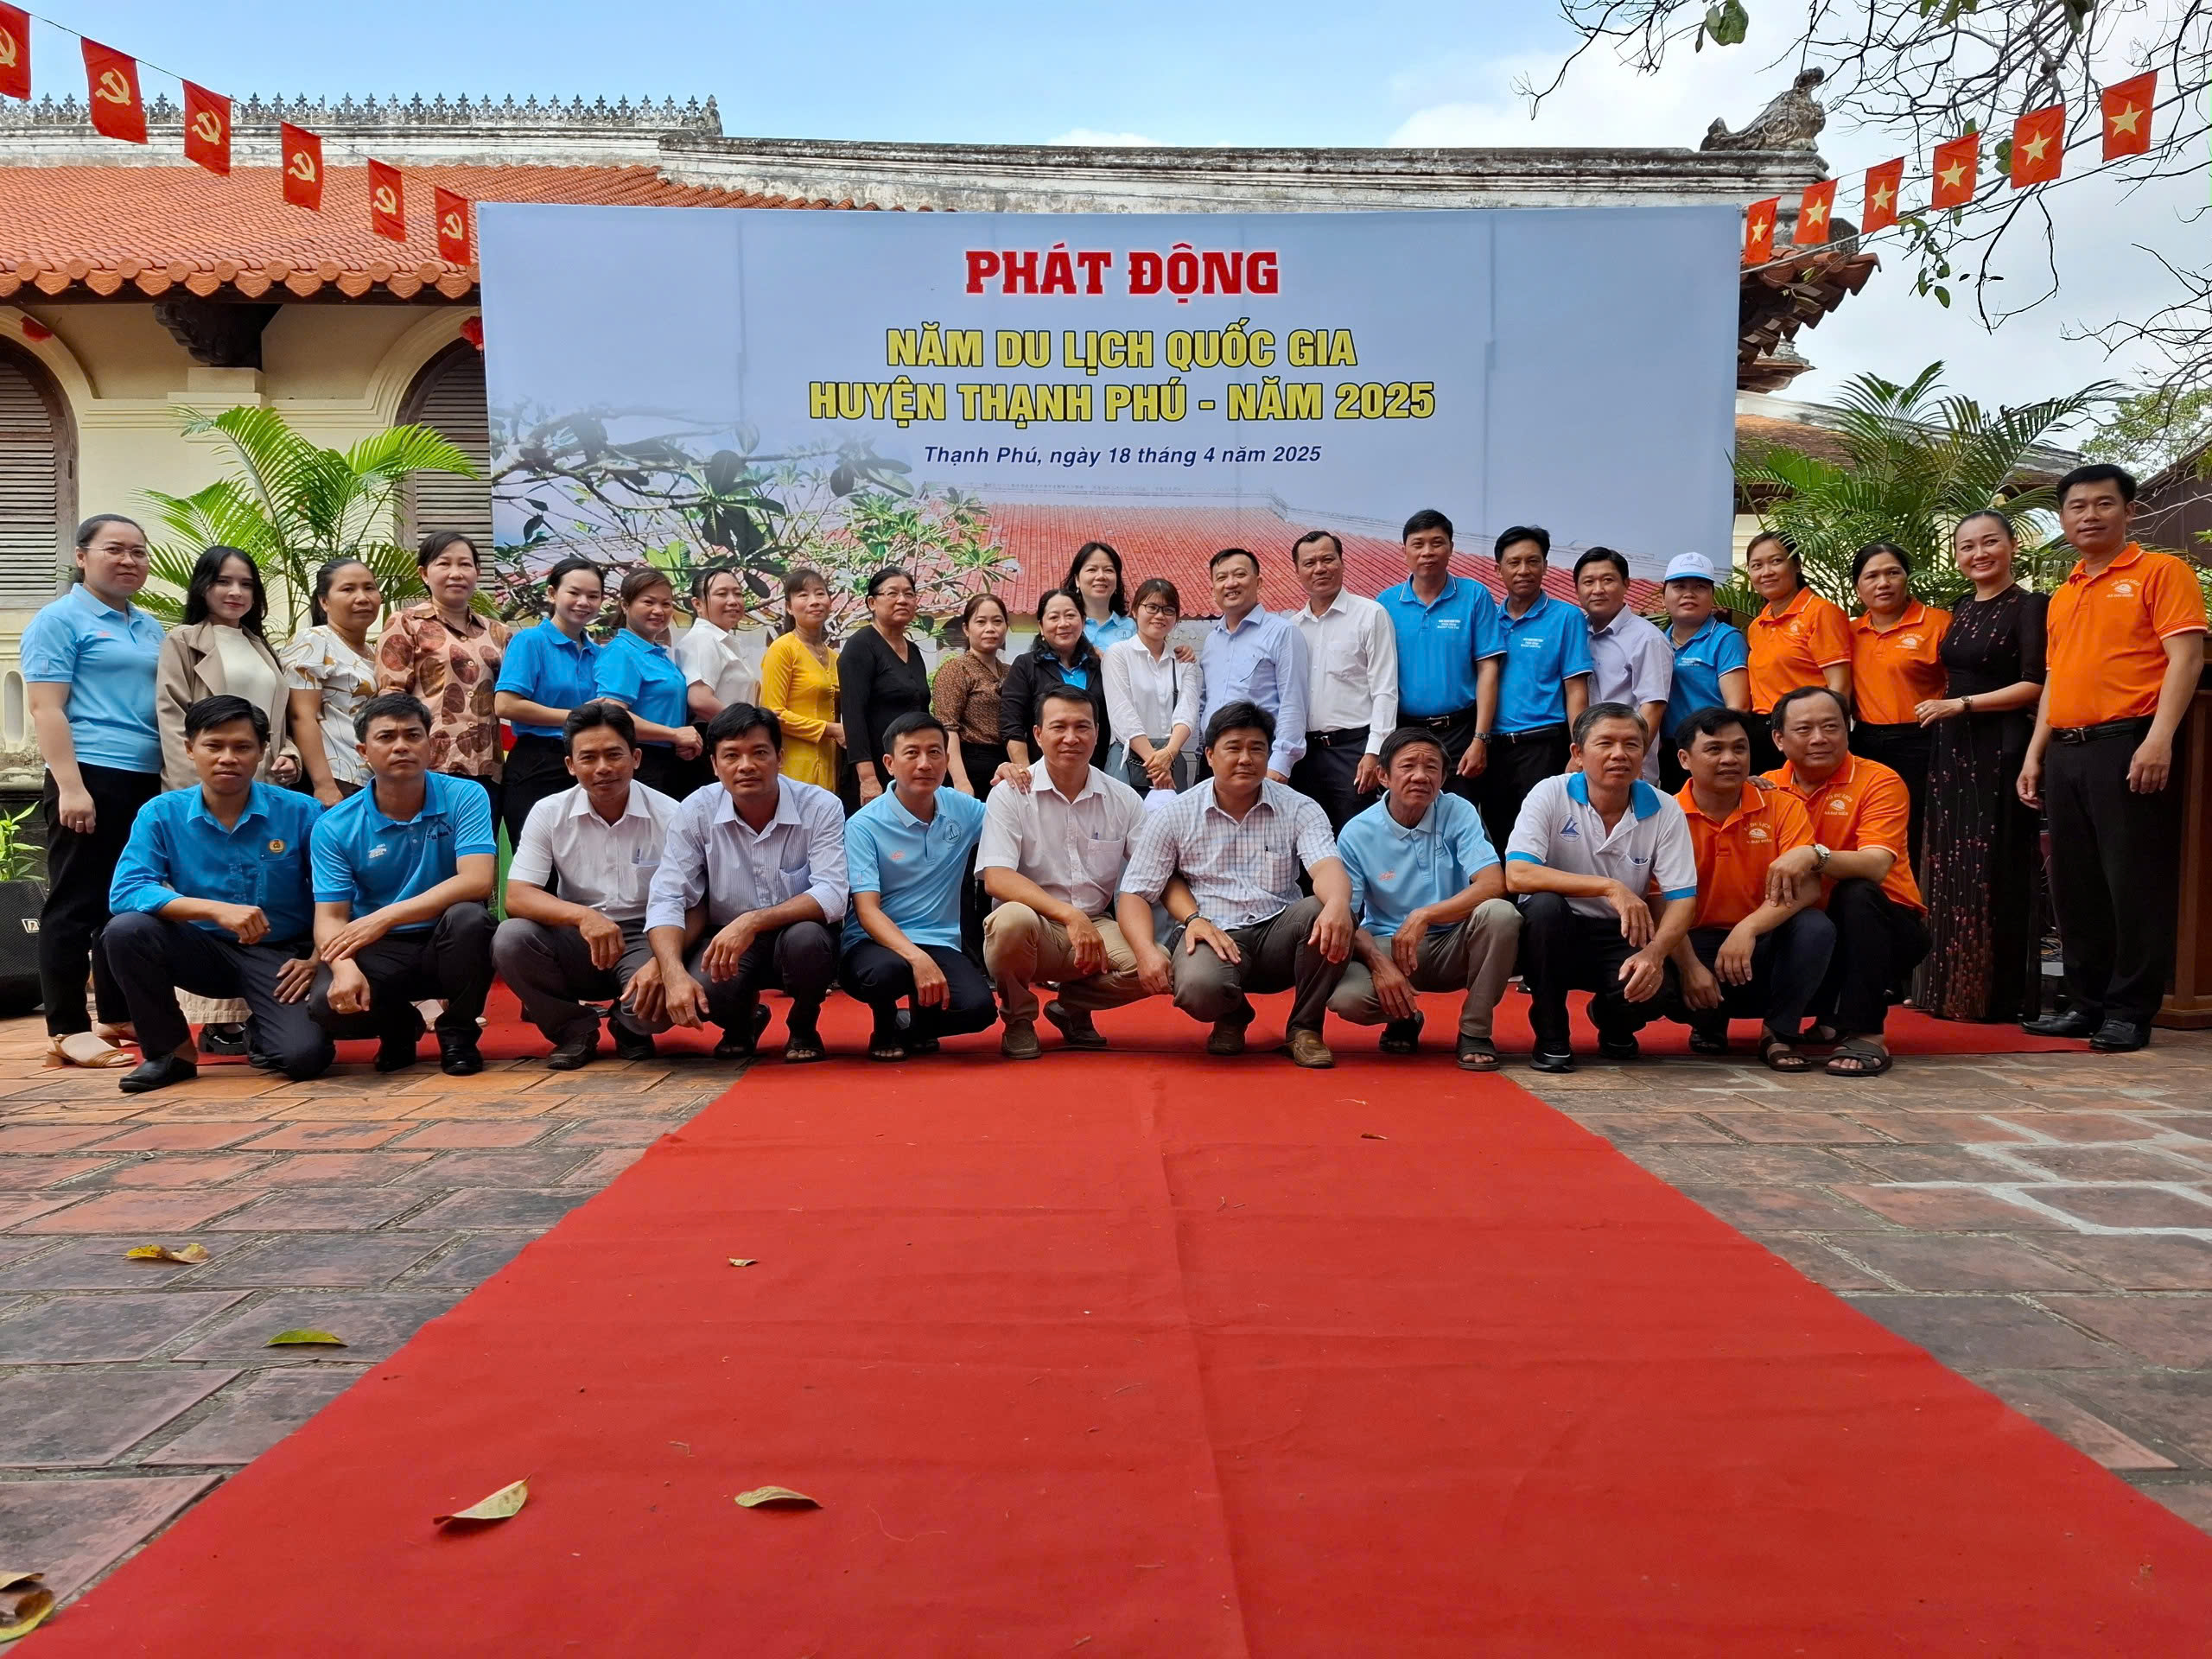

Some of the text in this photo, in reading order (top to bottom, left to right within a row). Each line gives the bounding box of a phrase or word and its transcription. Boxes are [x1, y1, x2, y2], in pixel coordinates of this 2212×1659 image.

[966, 243, 1279, 304] PHÁT ĐỘNG
[887, 317, 1357, 376] NĂM DU LỊCH QUỐC GIA
[810, 375, 1435, 429] HUYỆN THẠNH PHÚ - NĂM 2025
[925, 446, 1322, 467] Thạnh Phú, ngày 18 tháng 4 năm 2025
